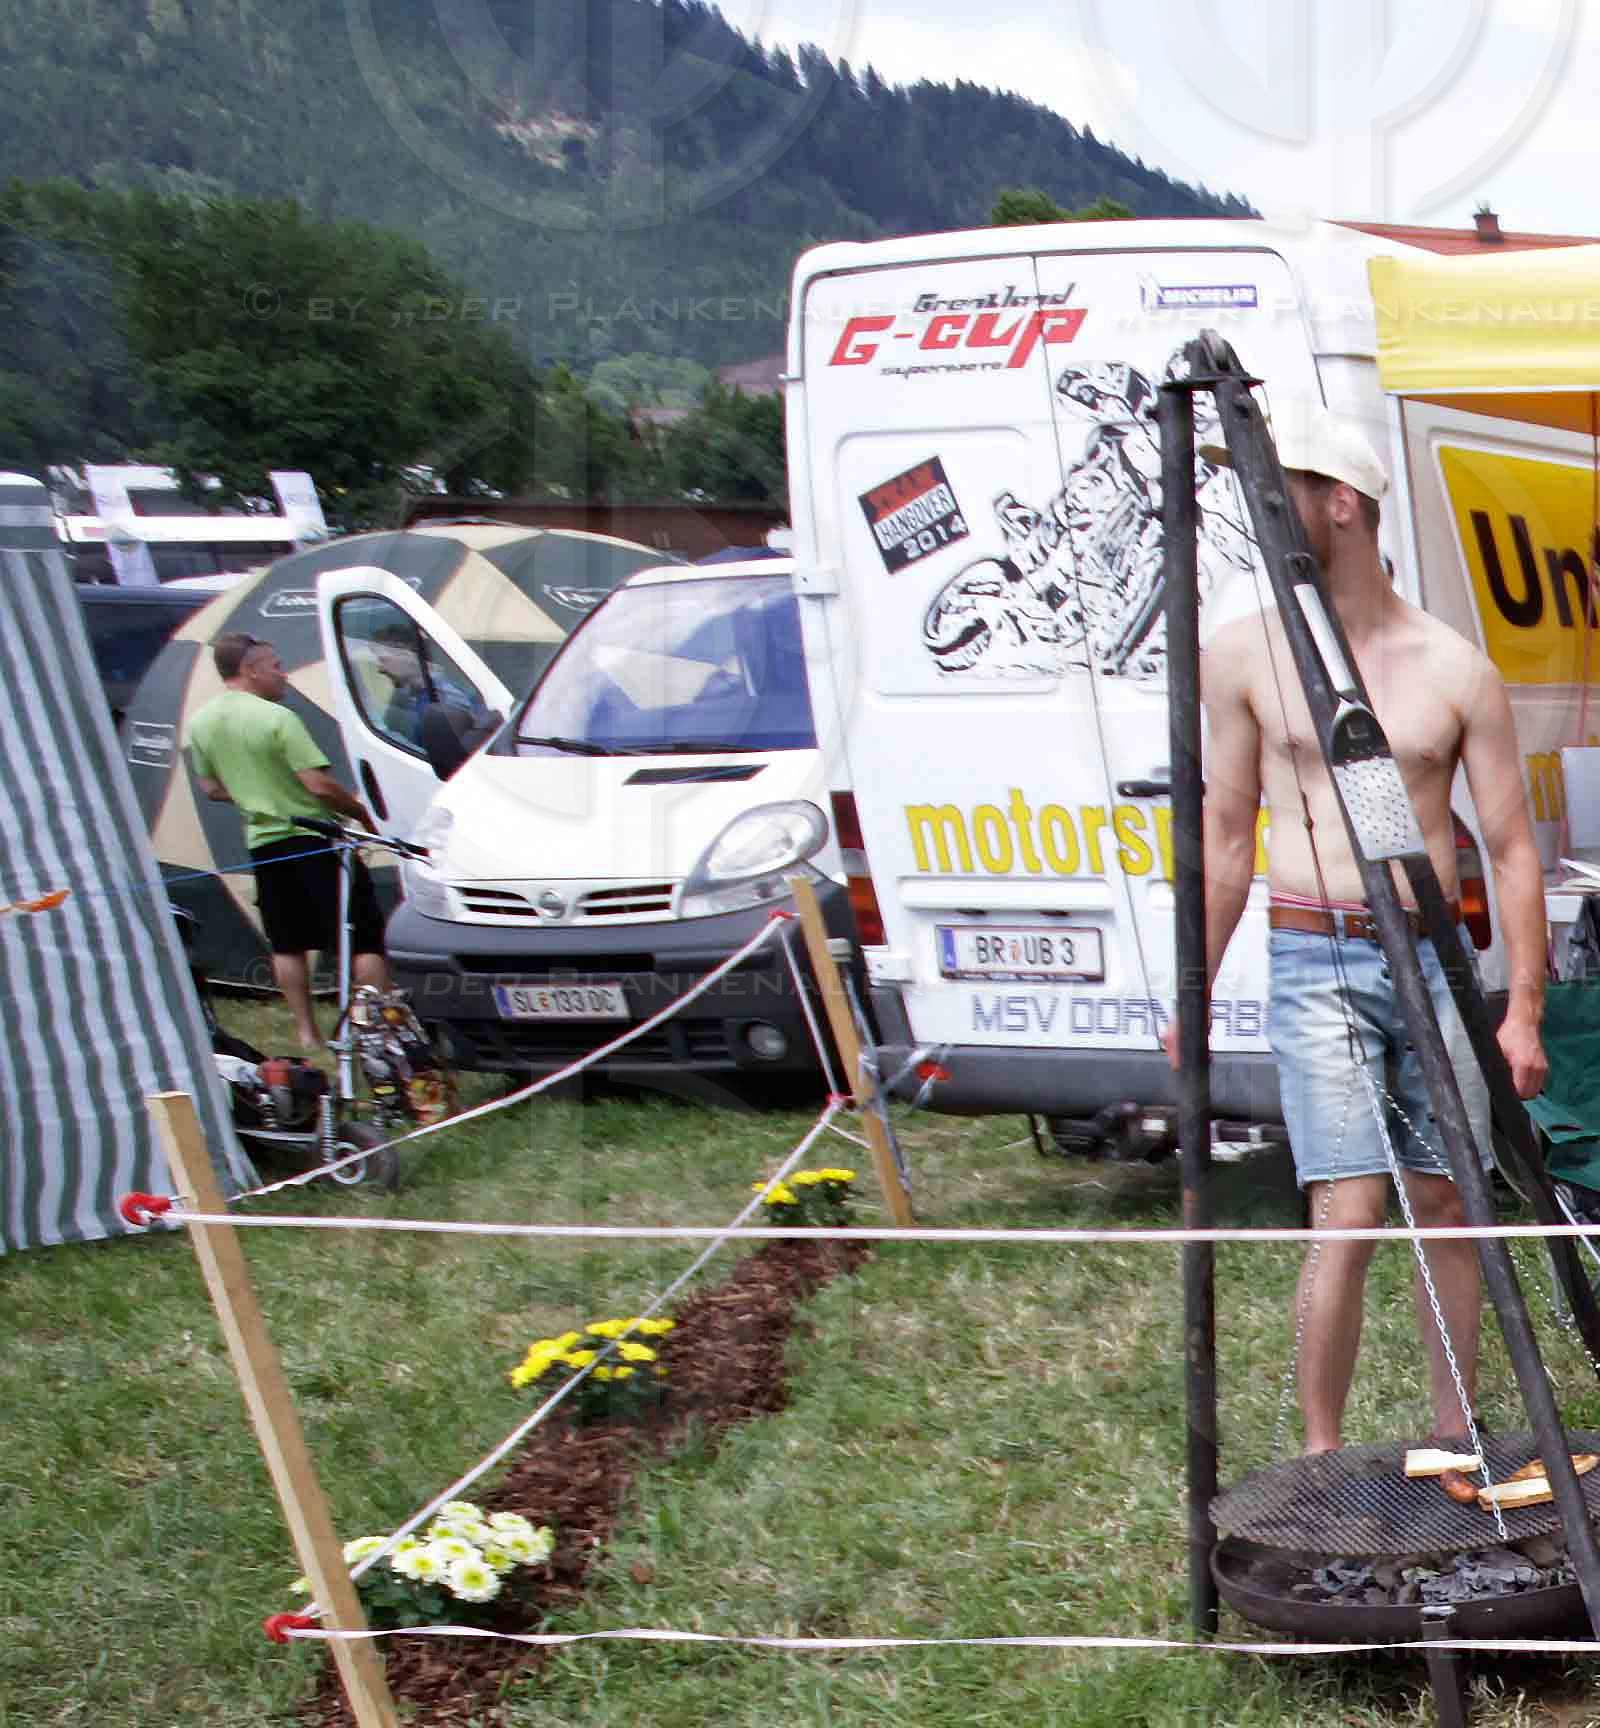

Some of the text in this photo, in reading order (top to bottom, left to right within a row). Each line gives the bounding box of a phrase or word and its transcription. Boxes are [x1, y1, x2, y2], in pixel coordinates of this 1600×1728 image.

[903, 514, 968, 560] 2014
[974, 936, 1077, 965] BR UB 3
[972, 993, 1060, 1033] MSV
